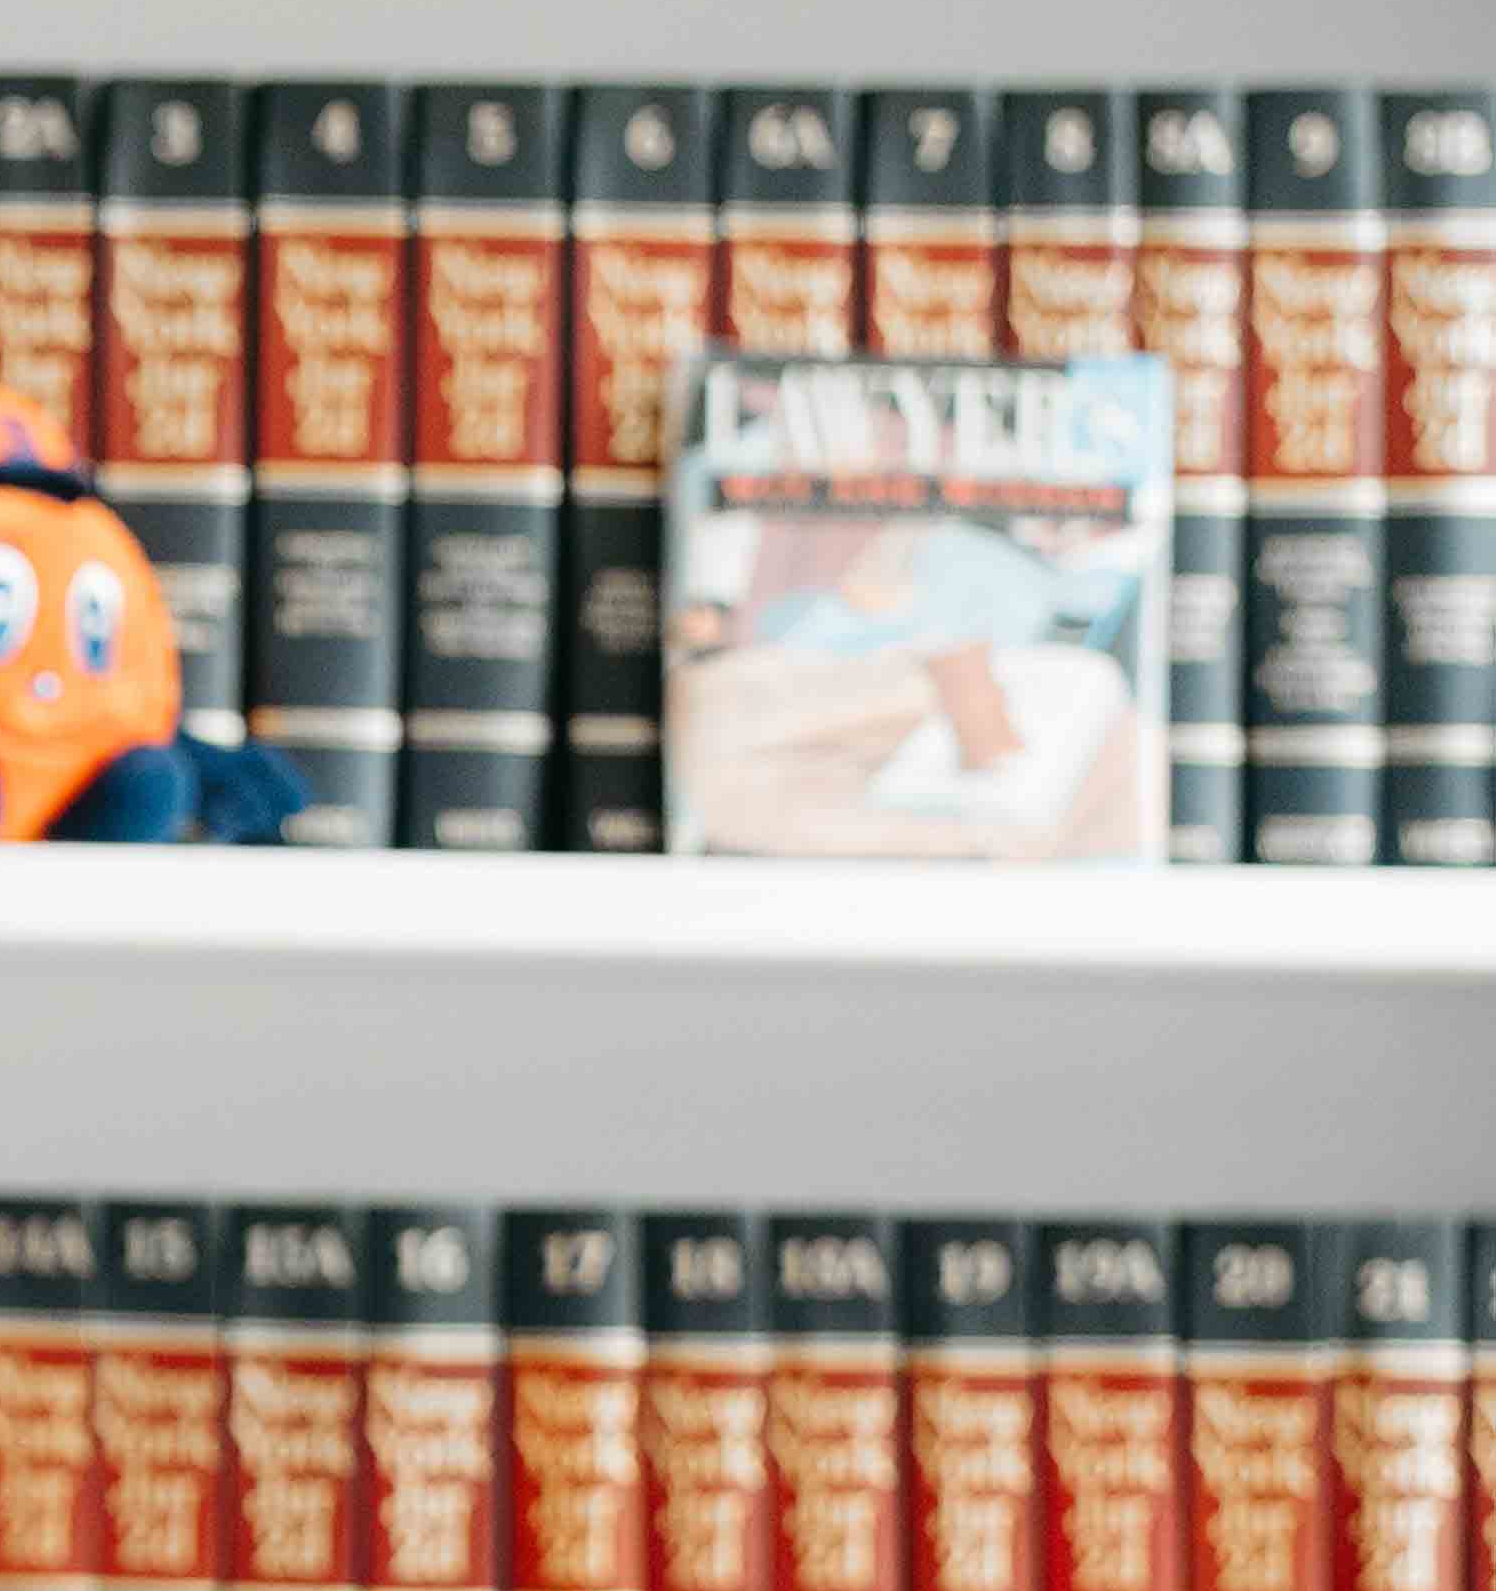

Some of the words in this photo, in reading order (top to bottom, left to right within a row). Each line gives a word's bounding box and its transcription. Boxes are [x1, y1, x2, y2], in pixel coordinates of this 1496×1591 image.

[152, 101, 202, 164] 3
[624, 106, 675, 171] 6
[910, 108, 957, 172] 7
